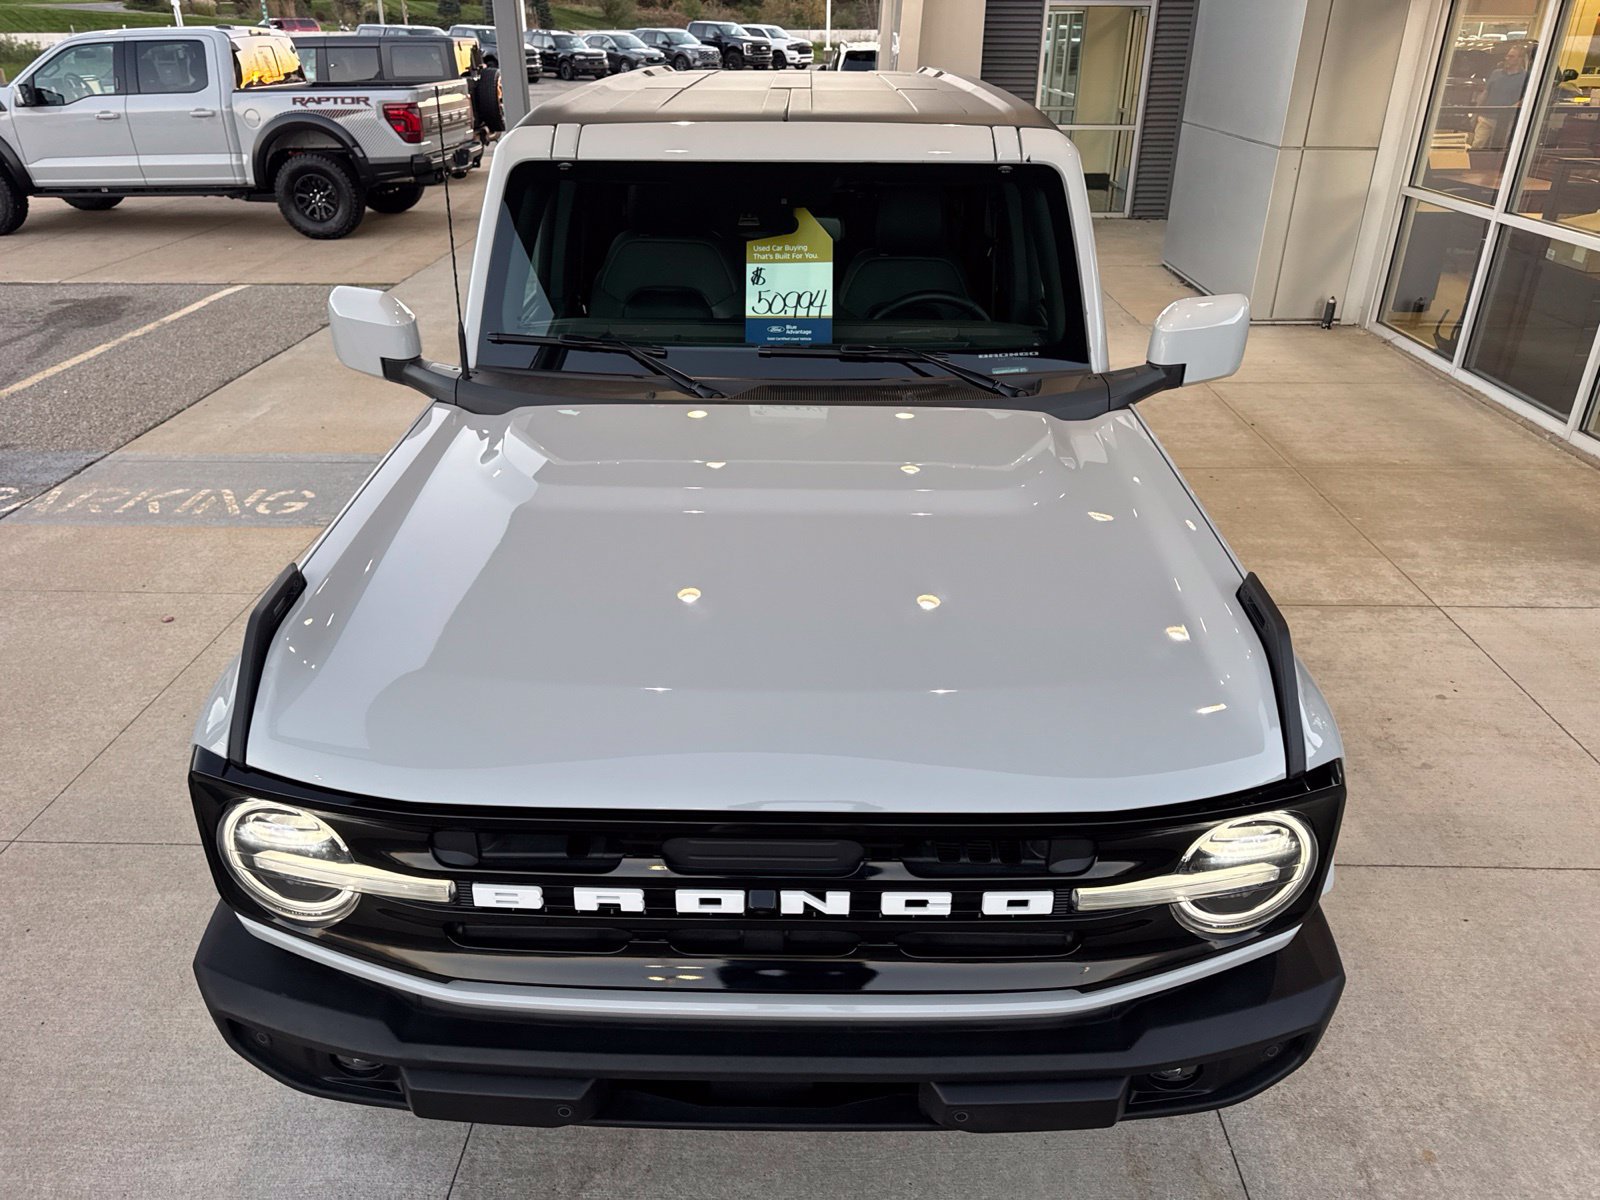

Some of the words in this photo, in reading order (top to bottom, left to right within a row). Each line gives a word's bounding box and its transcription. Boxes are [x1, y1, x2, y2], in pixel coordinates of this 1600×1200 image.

[292, 96, 373, 108] RAPTOR
[751, 267, 766, 286] $
[978, 351, 1038, 359] BRONCO
[472, 884, 1054, 916] BRONCO
